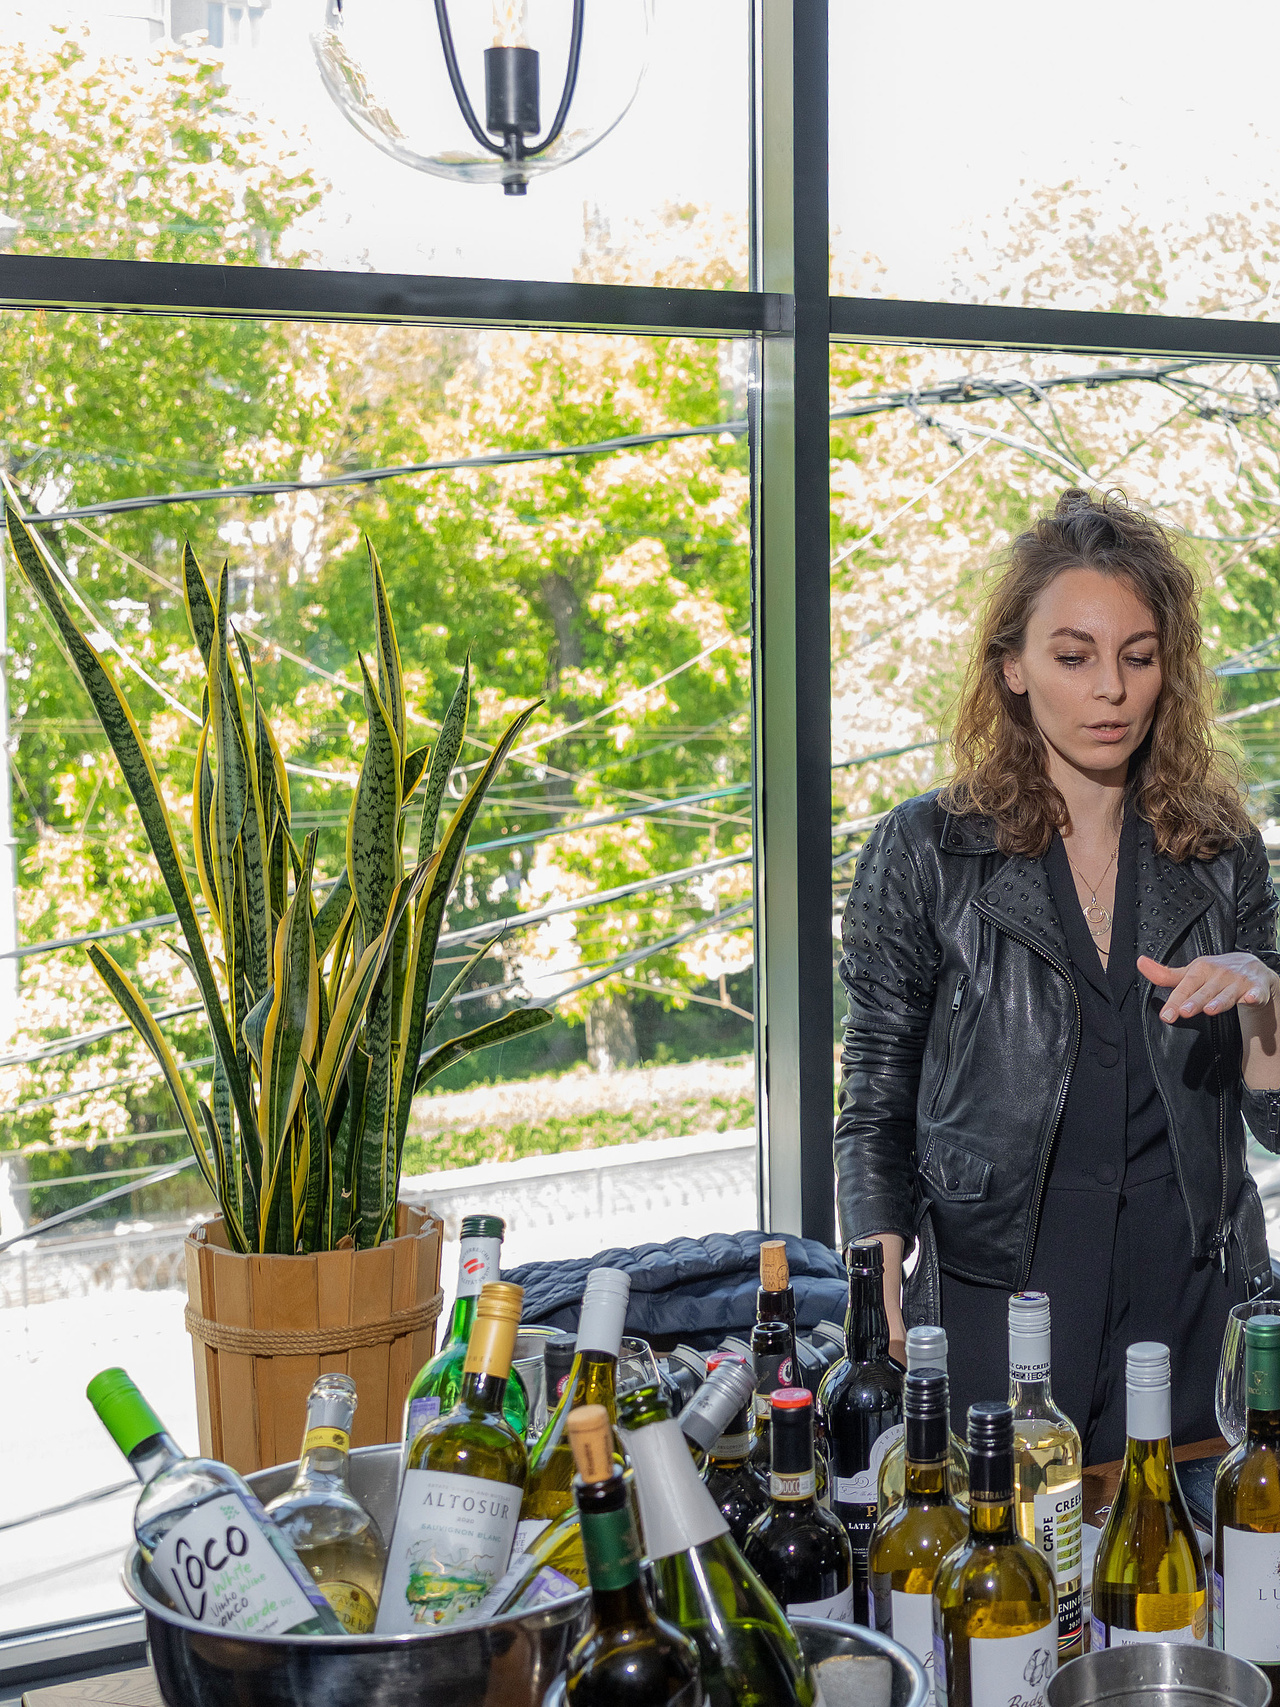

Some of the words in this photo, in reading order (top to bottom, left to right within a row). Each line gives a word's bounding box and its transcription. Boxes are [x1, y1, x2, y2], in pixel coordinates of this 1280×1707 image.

[423, 1492, 509, 1519] ALTOSUR
[421, 1523, 475, 1537] SAUVIGNON
[477, 1531, 501, 1543] BLANC
[848, 1522, 870, 1530] LATE
[1043, 1516, 1053, 1552] CAPE
